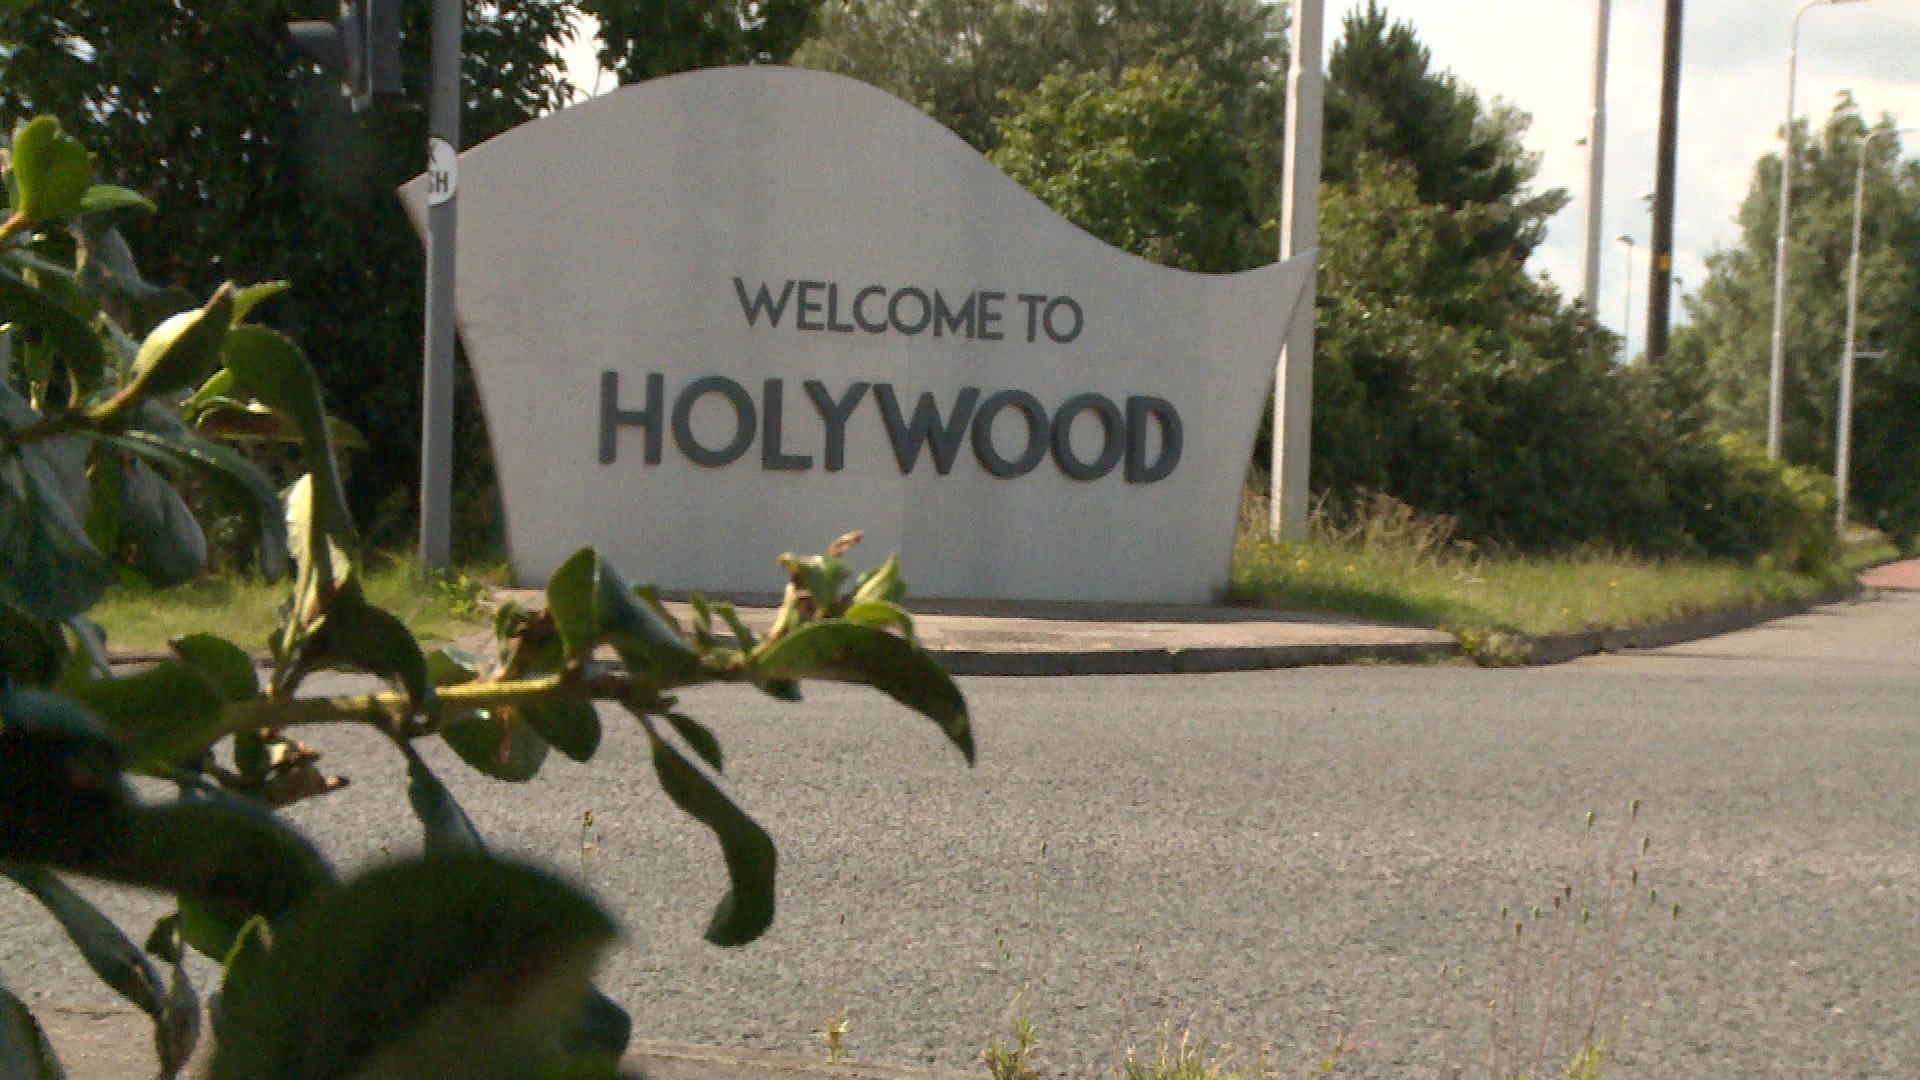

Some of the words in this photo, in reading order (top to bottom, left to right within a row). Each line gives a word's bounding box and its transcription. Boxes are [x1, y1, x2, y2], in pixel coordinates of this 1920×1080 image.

[733, 276, 1006, 341] WELCOME
[1018, 293, 1085, 345] TO
[599, 370, 1185, 485] HOLYWOOD
